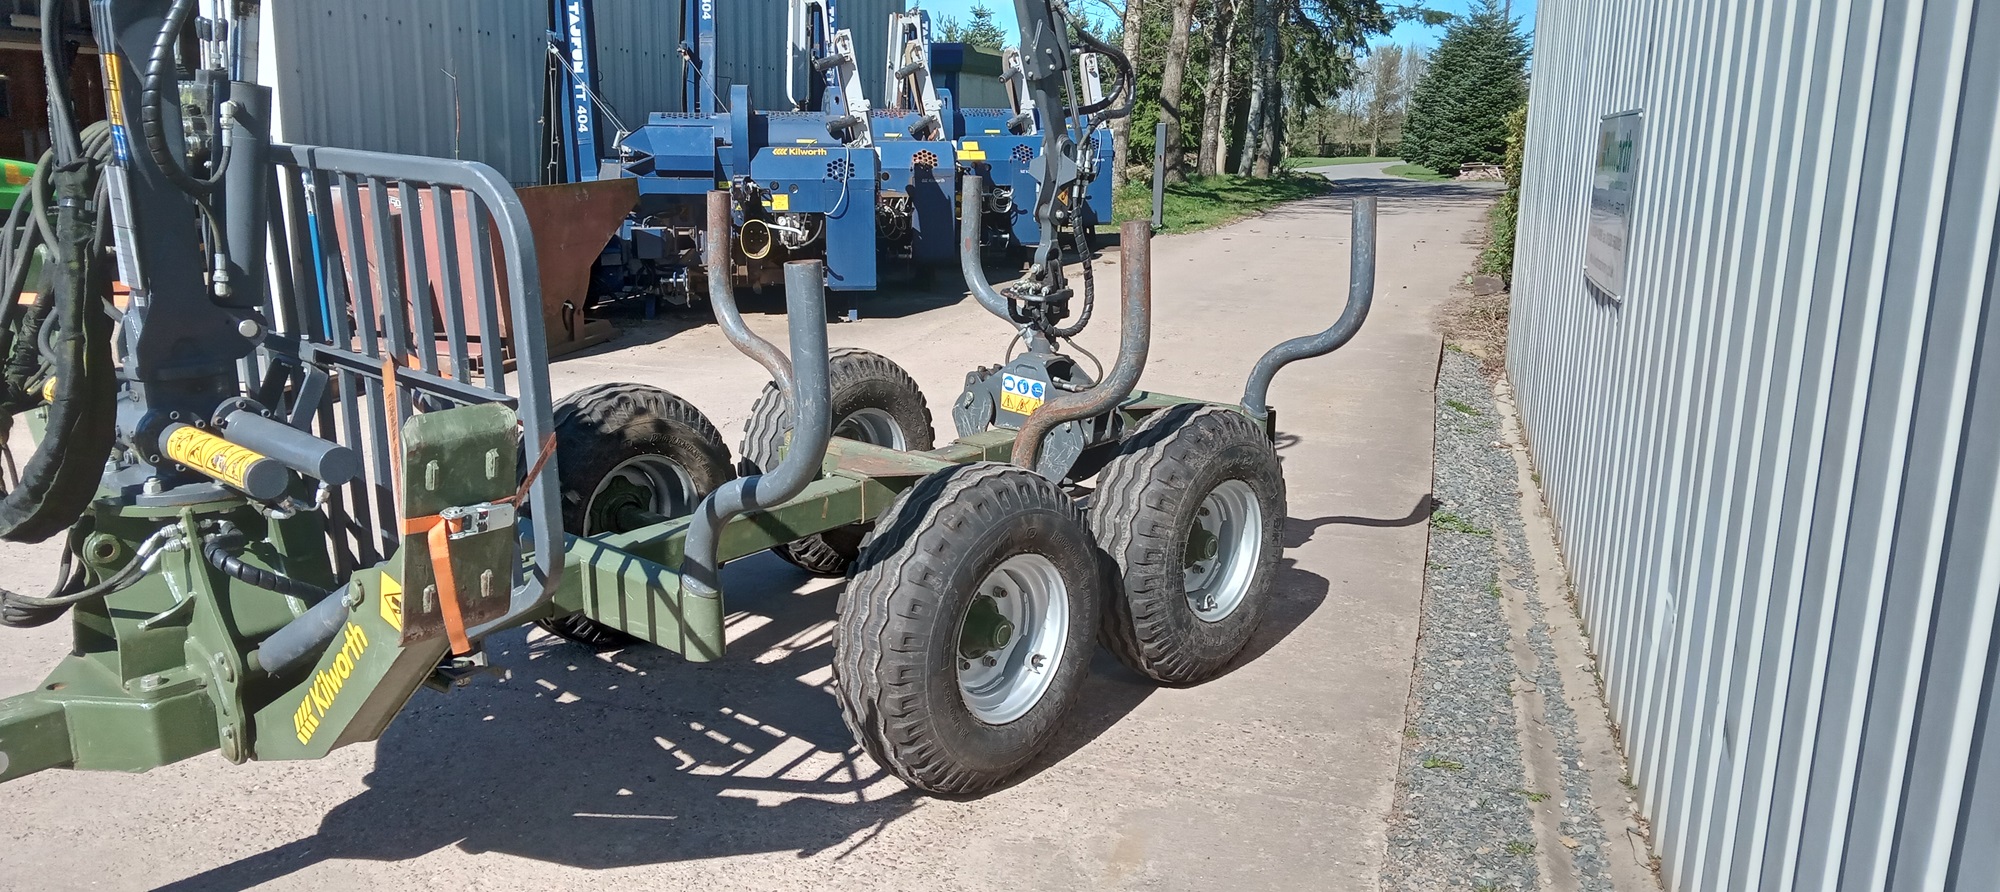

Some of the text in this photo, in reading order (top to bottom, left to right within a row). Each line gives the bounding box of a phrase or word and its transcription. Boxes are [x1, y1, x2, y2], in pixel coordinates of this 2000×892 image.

[568, 1, 589, 133] TAJFUN TT 404
[789, 147, 827, 156] Kilworth
[308, 621, 369, 718] Kilworth
